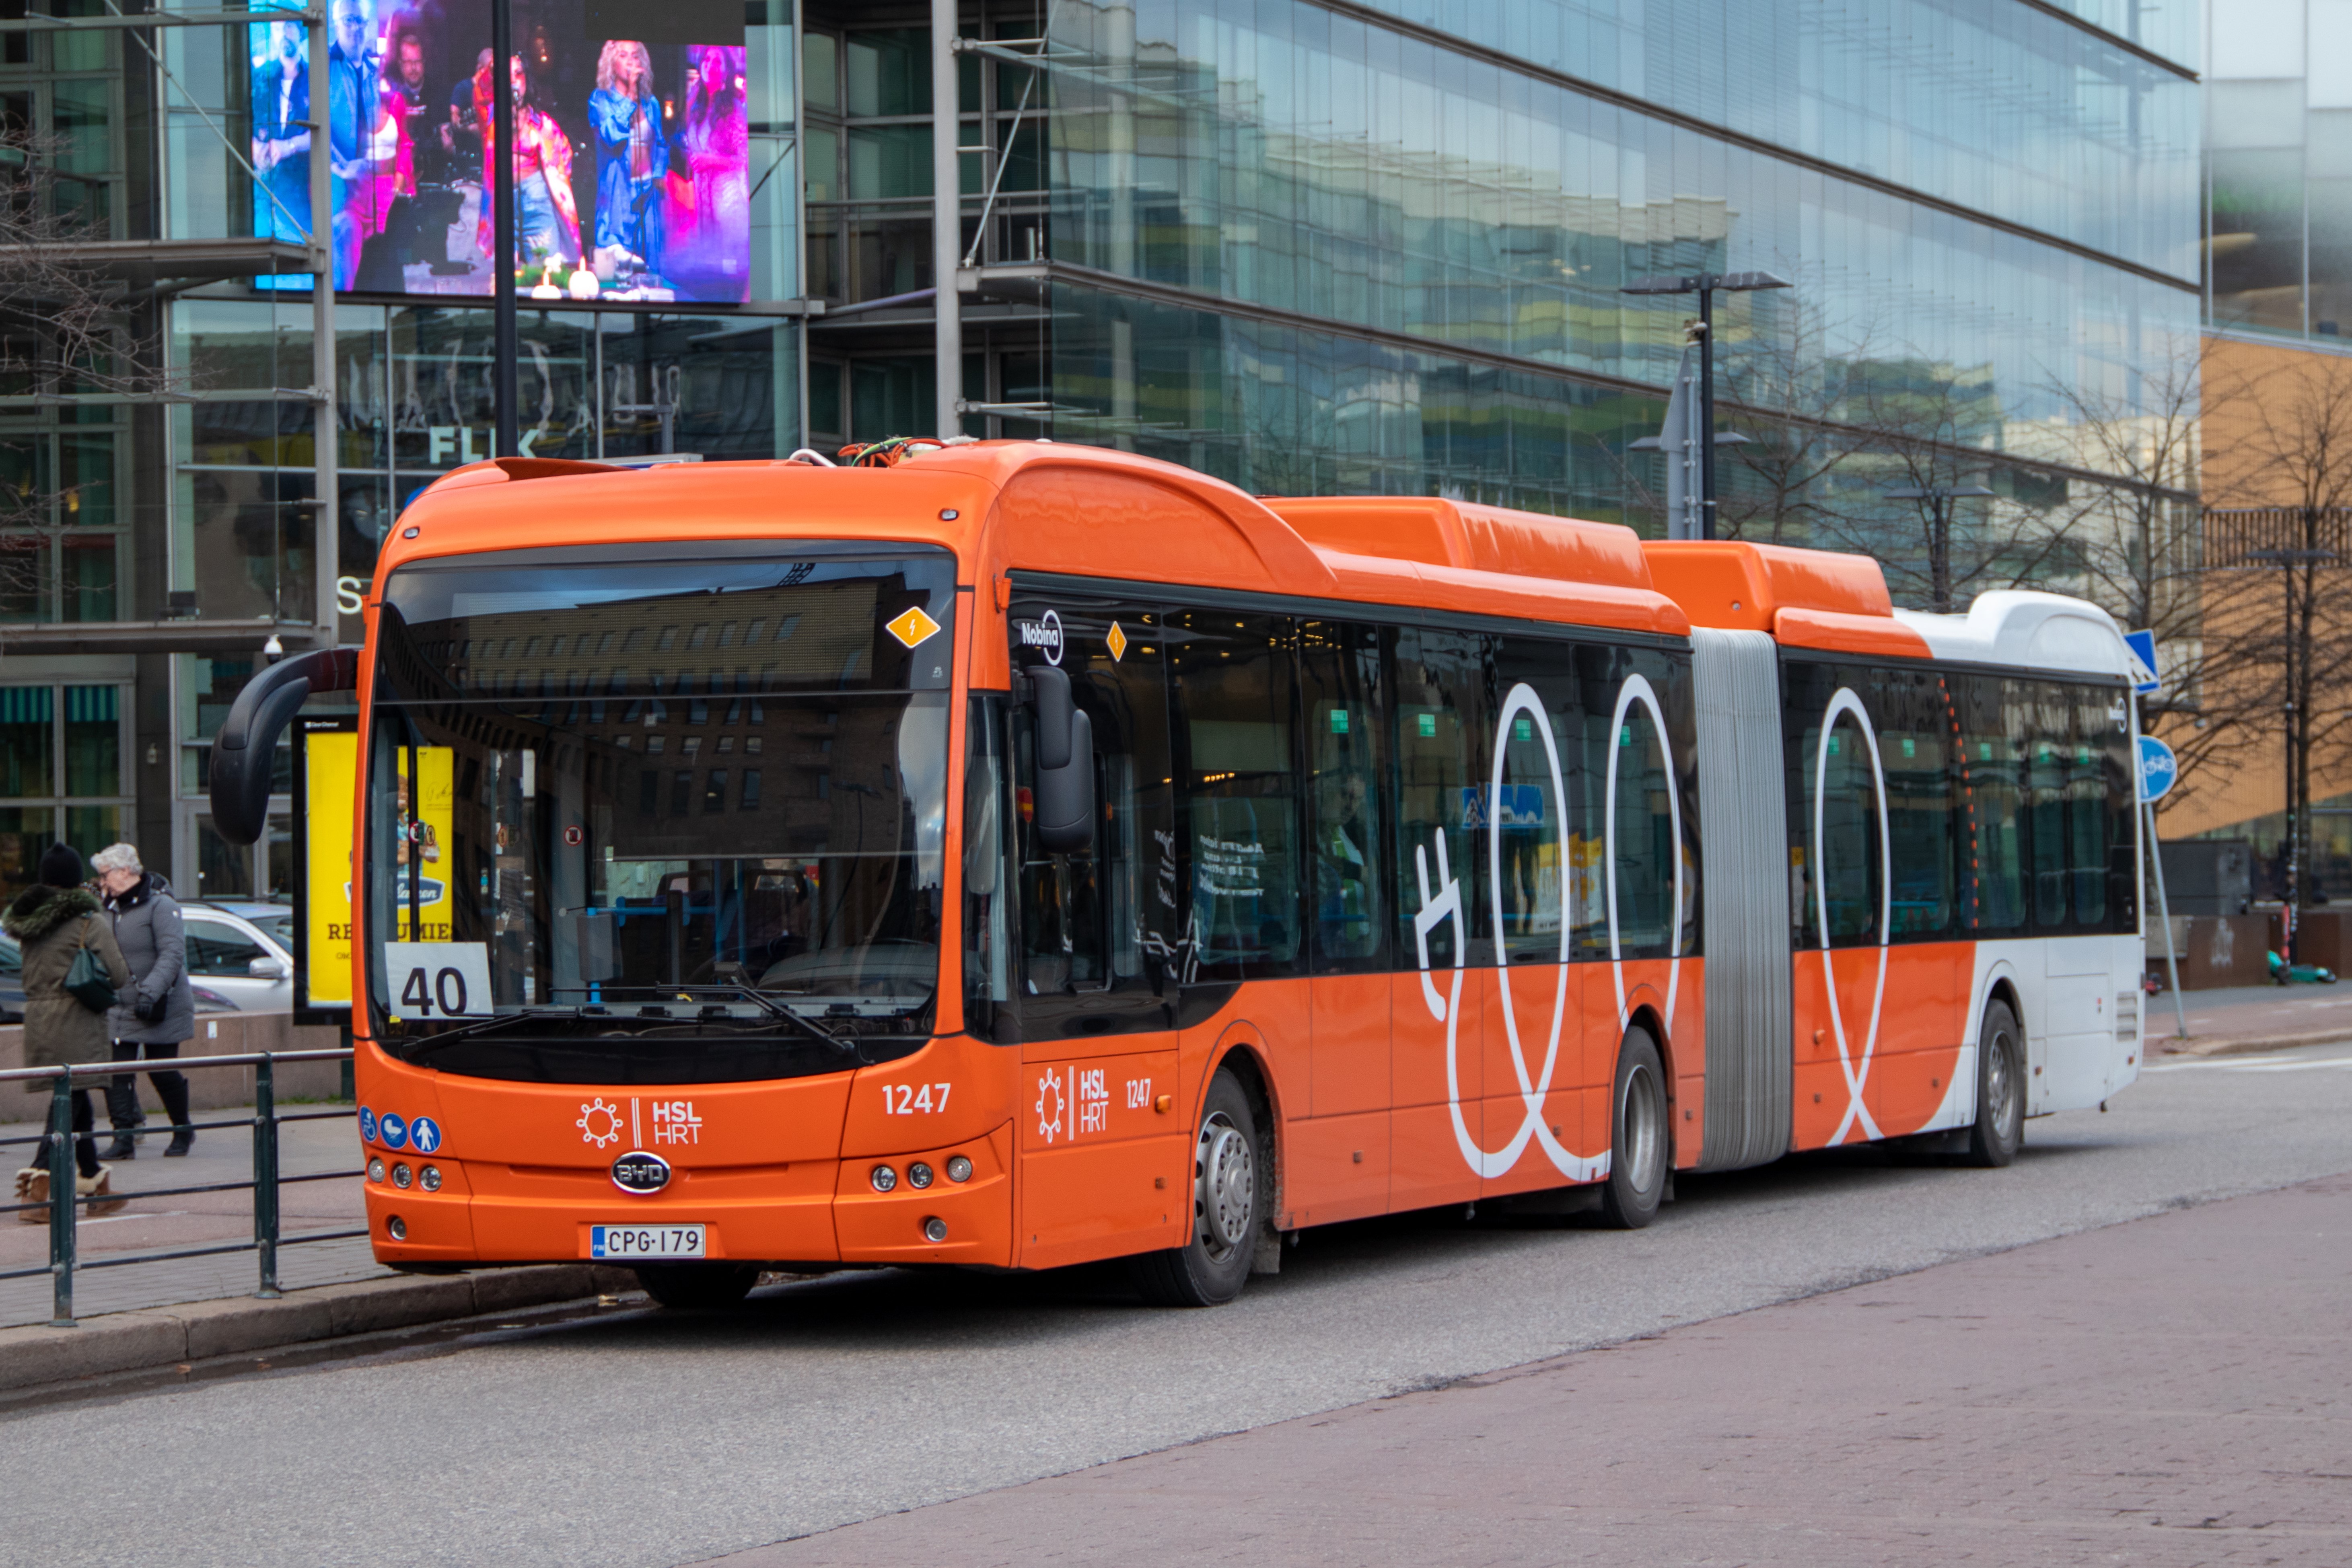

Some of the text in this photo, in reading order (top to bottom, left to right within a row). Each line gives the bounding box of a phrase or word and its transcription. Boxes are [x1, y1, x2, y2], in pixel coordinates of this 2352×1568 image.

[1022, 623, 1059, 646] Nobina
[401, 967, 467, 1017] 40
[882, 1083, 951, 1114] 1247
[1081, 1069, 1109, 1101] HSL
[1127, 1078, 1151, 1109] 1247
[652, 1101, 702, 1122] HSL
[1081, 1101, 1109, 1133] HRT
[654, 1124, 703, 1145] HRT
[617, 1165, 663, 1182] BYD
[609, 1231, 698, 1252] CPG-179
